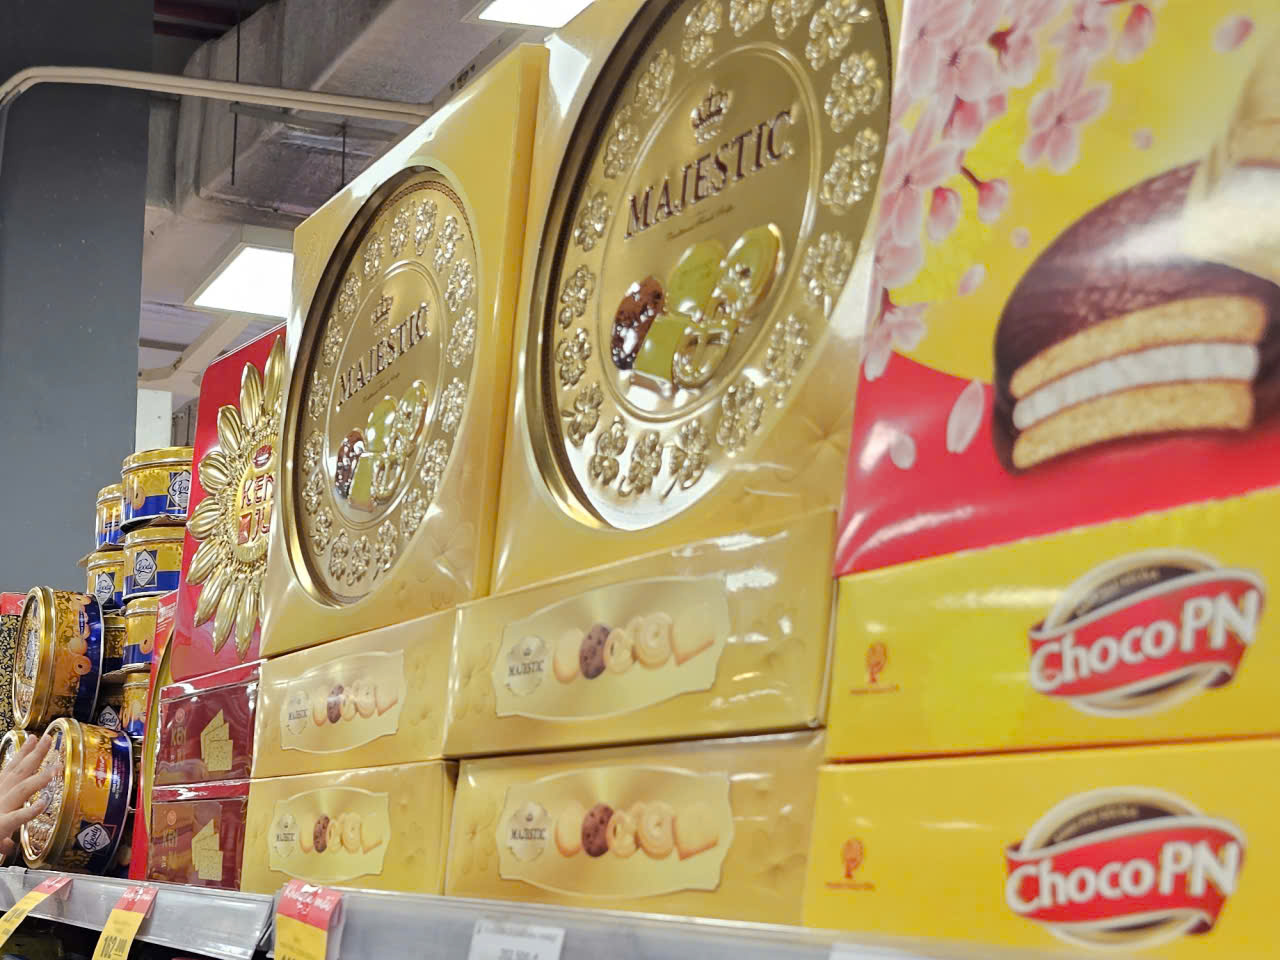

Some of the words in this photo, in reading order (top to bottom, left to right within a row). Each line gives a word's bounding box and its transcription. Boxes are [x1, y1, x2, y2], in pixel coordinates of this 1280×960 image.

[624, 109, 795, 241] MAJESTIC
[336, 303, 431, 414] MAJESTIC
[136, 557, 156, 579] Goody
[83, 824, 106, 853] Goody
